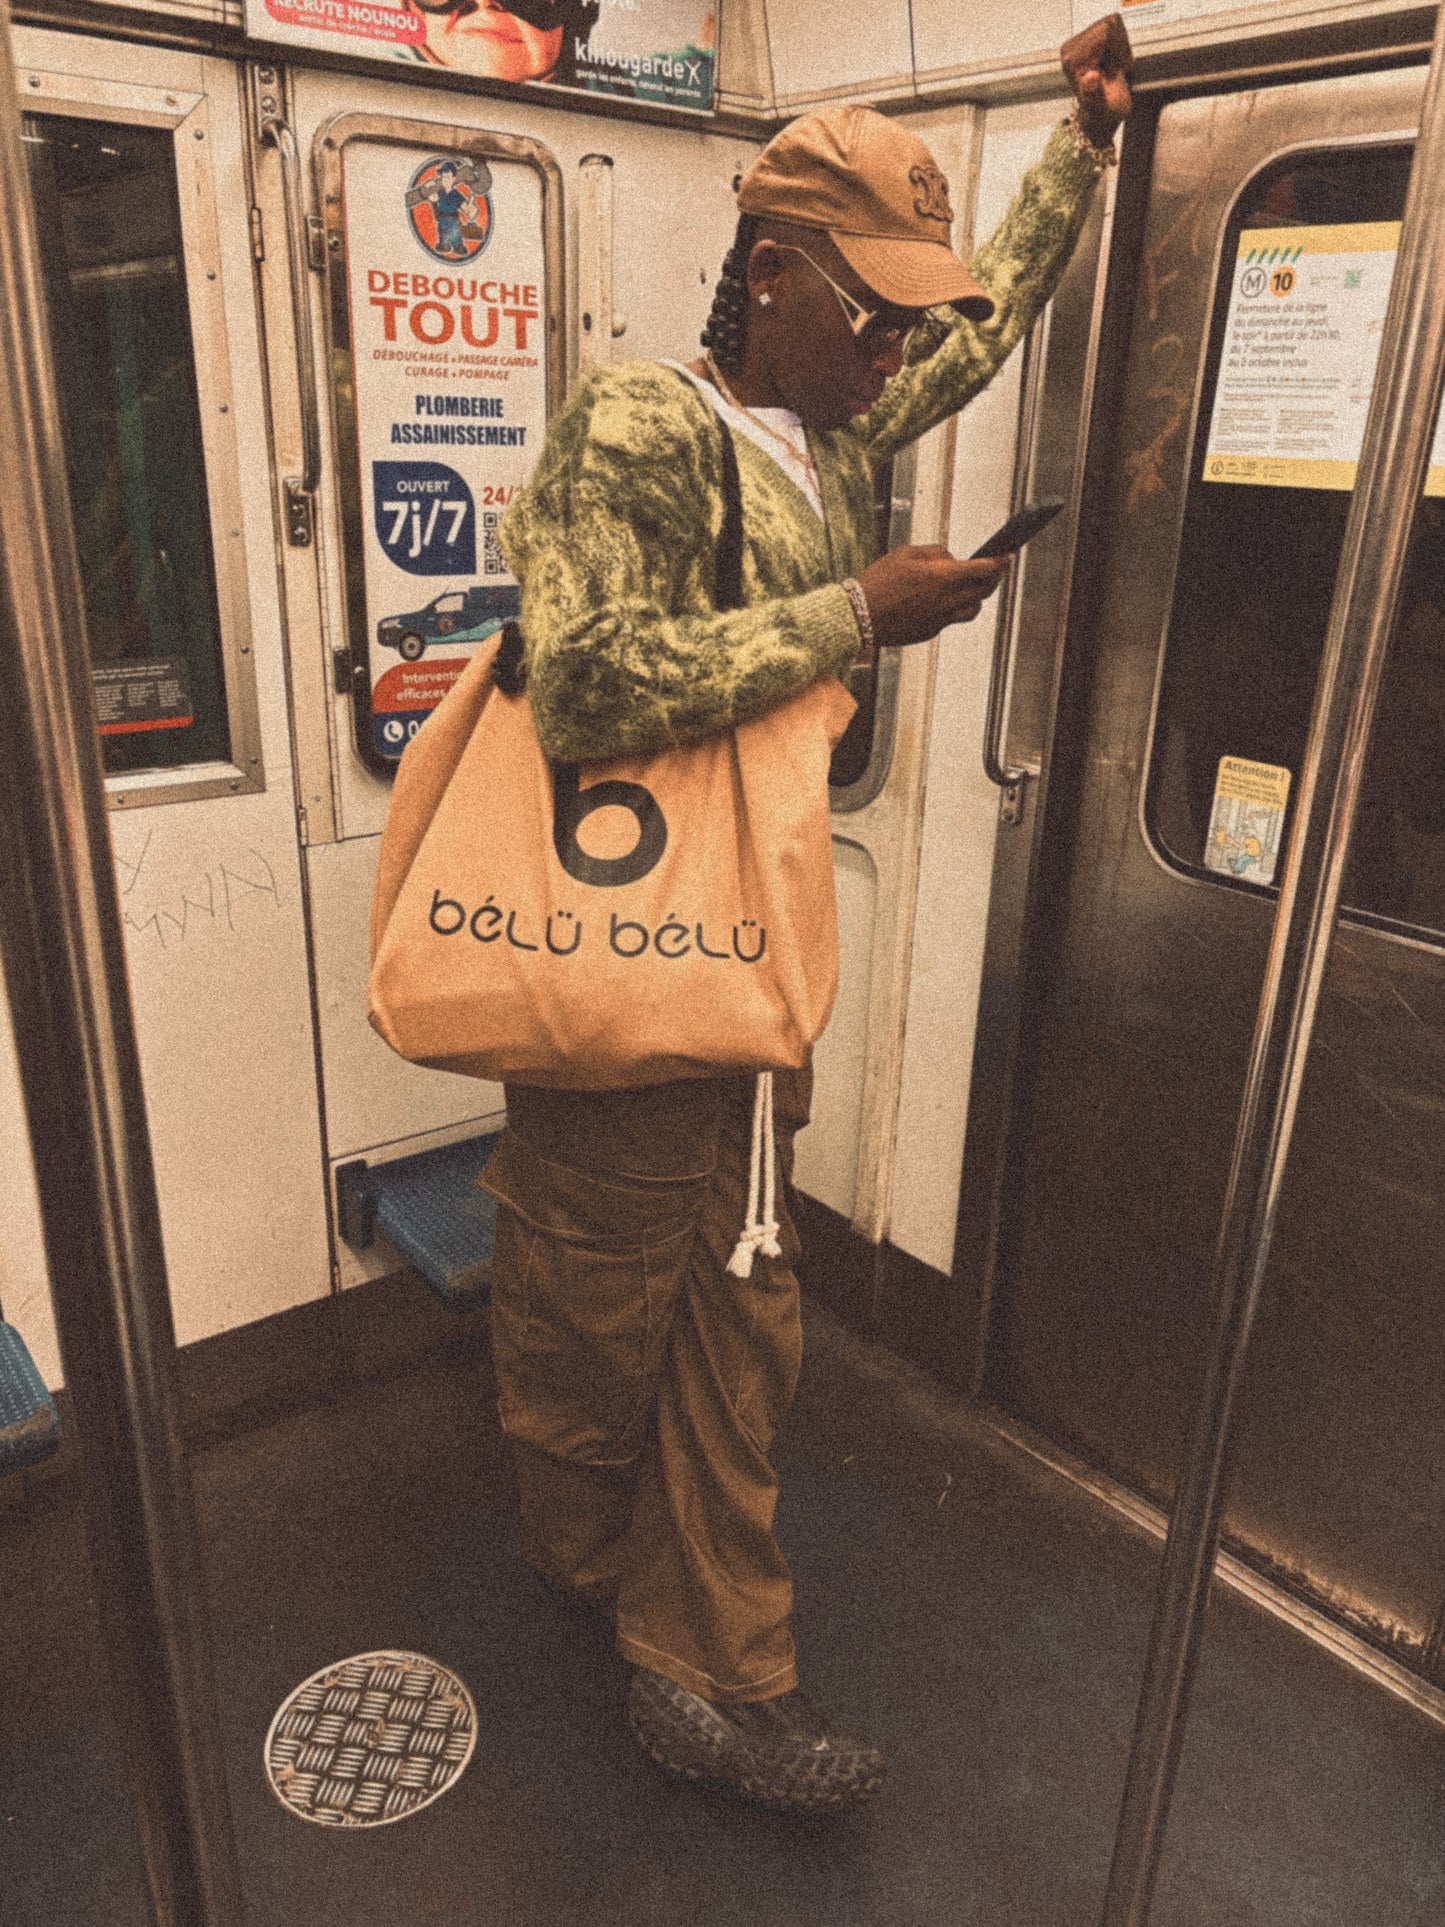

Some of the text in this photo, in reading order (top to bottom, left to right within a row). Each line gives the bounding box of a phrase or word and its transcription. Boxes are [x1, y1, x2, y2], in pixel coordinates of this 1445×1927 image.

[348, 7, 419, 32] NOUNOU
[367, 269, 538, 307] DEBOUCHE
[1273, 271, 1294, 291] 10
[369, 296, 539, 350] TOUT
[457, 354, 498, 366] PASSAGE
[500, 355, 539, 367] CAMÉRA
[405, 365, 510, 381] CURAGE POMPAGE
[415, 394, 504, 419] PLOMBERIE
[391, 422, 527, 447] ASSAINISSEMENT
[396, 480, 450, 493] OUVERT
[482, 486, 520, 506] 24/
[382, 498, 467, 559] 7j/7
[1224, 761, 1280, 780] Attention
